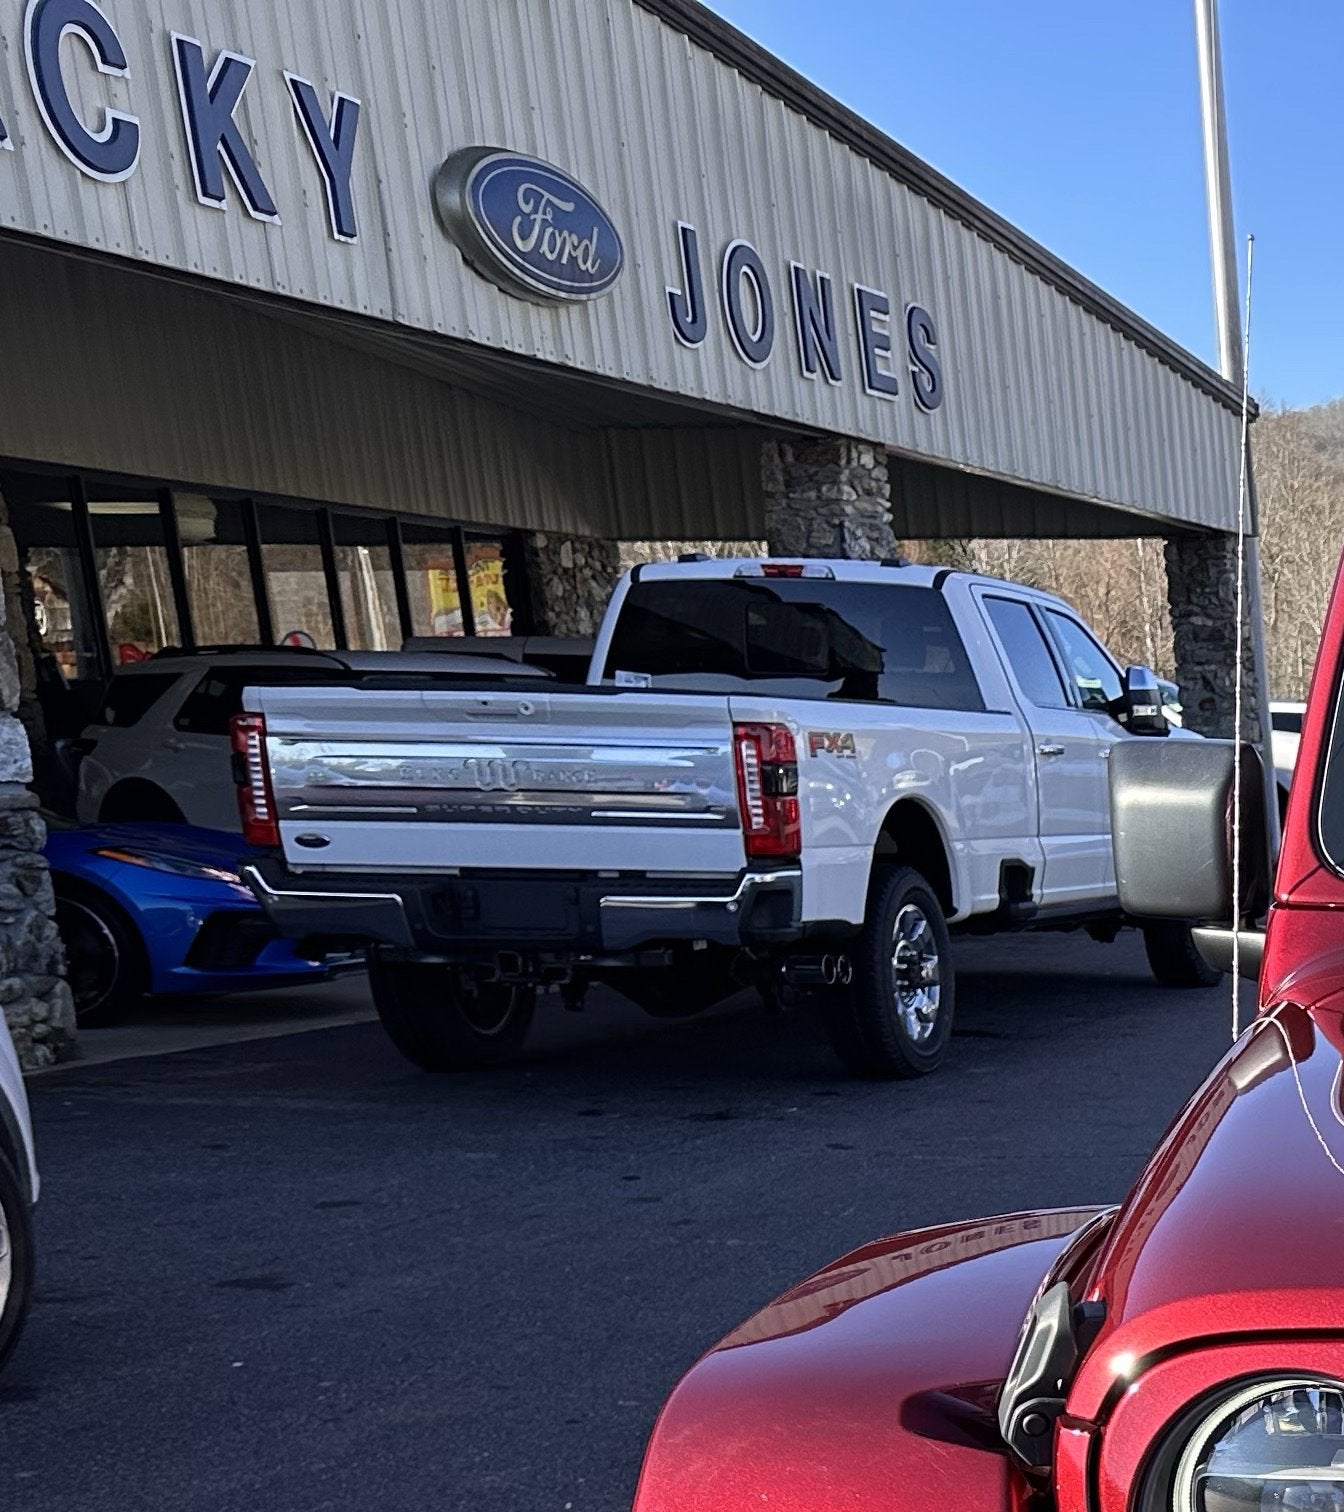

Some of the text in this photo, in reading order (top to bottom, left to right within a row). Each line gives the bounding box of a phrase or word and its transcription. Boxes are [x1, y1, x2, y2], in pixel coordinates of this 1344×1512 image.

[0, 0, 359, 245] CKY
[511, 182, 601, 275] Ford
[664, 219, 945, 415] JONES
[808, 732, 856, 758] FX4
